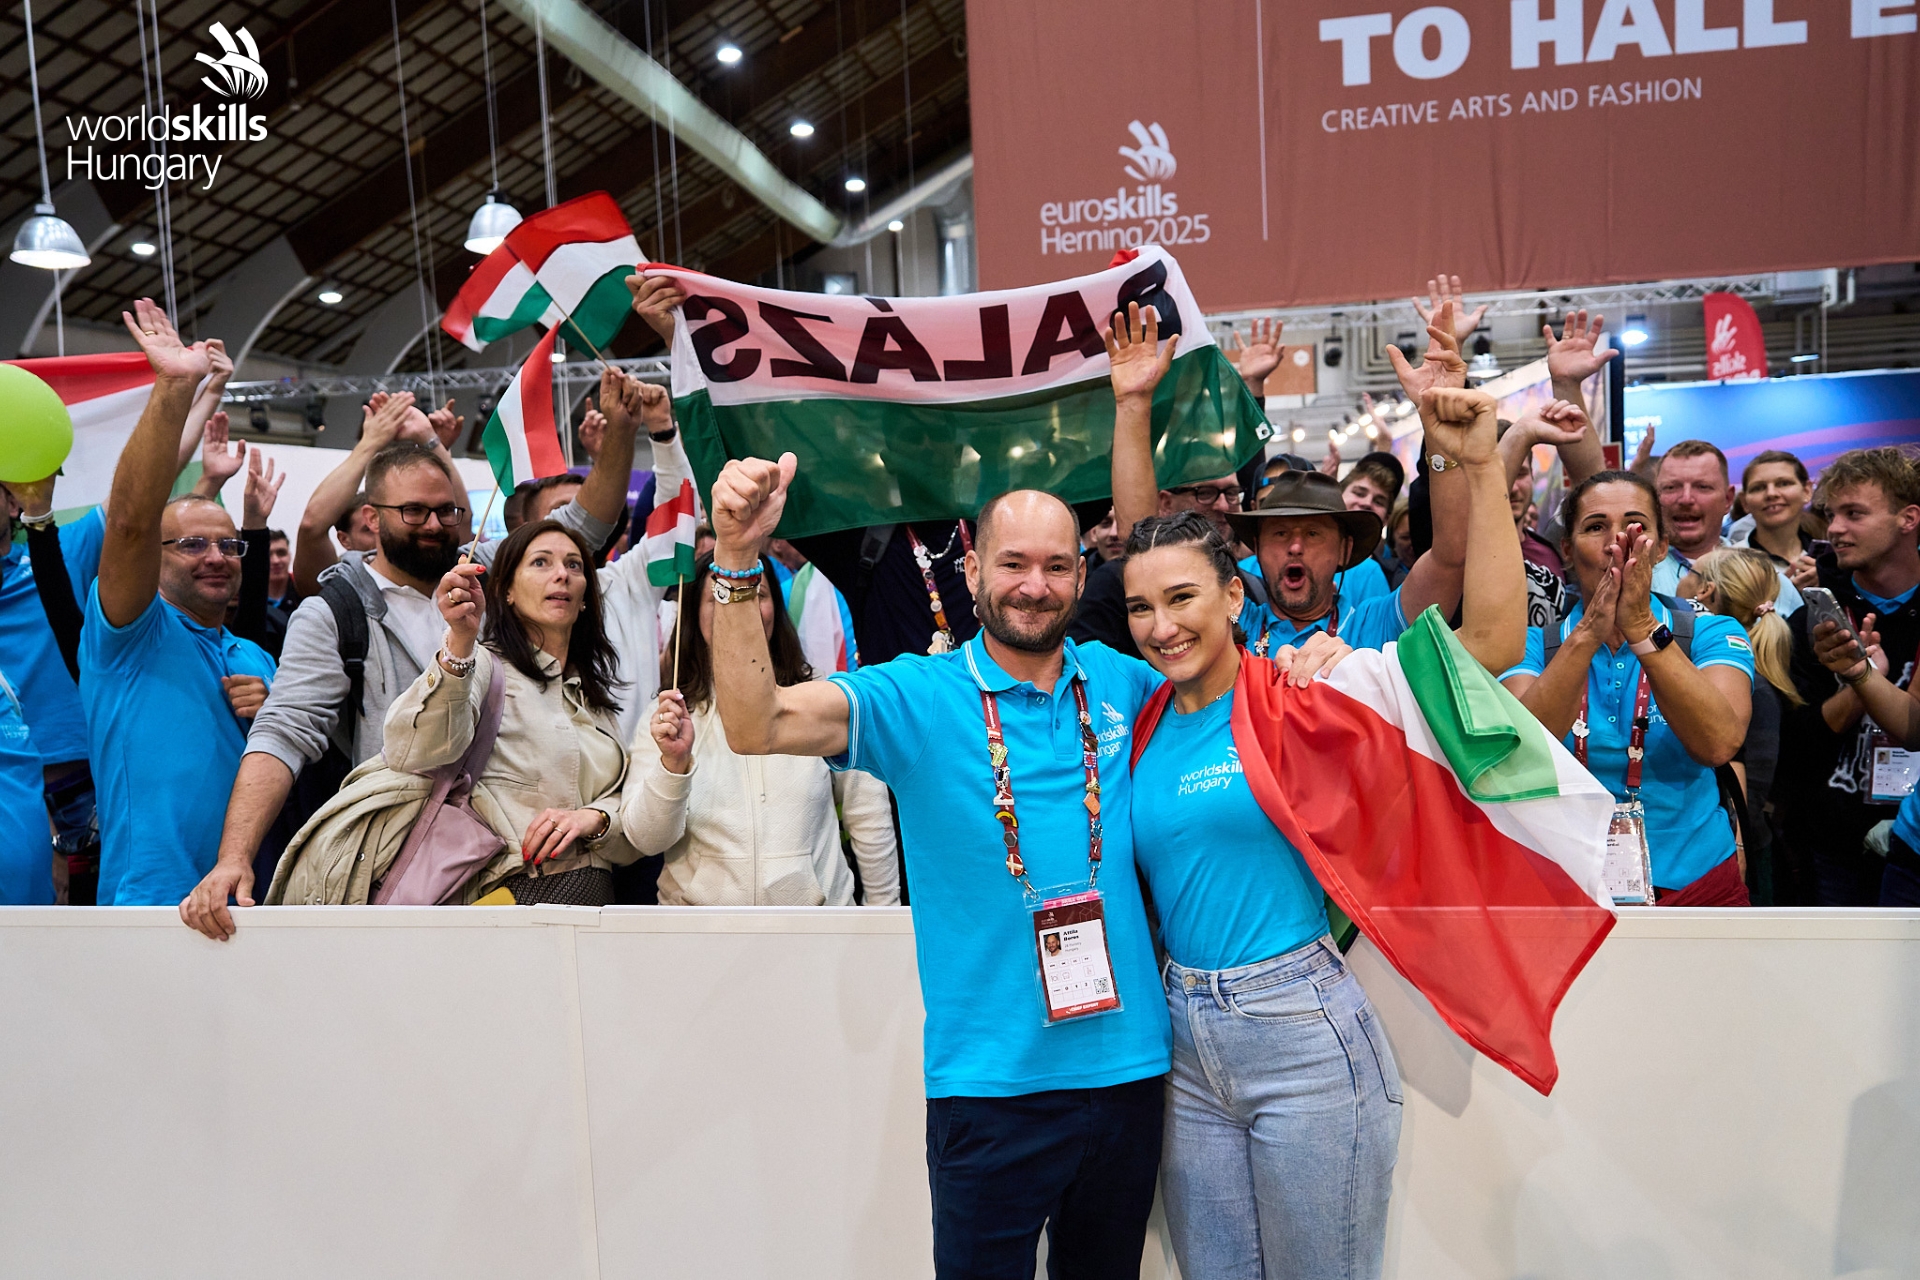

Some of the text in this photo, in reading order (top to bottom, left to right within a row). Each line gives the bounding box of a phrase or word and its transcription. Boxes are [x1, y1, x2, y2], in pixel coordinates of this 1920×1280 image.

[1319, 6, 1471, 87] TO
[1510, 0, 1807, 69] HALL
[1321, 77, 1702, 132] CREATIVE ARTS AND FASHION
[1040, 184, 1178, 226] euroskills
[1178, 776, 1232, 796] Hungary
[1180, 759, 1244, 784] worldskill
